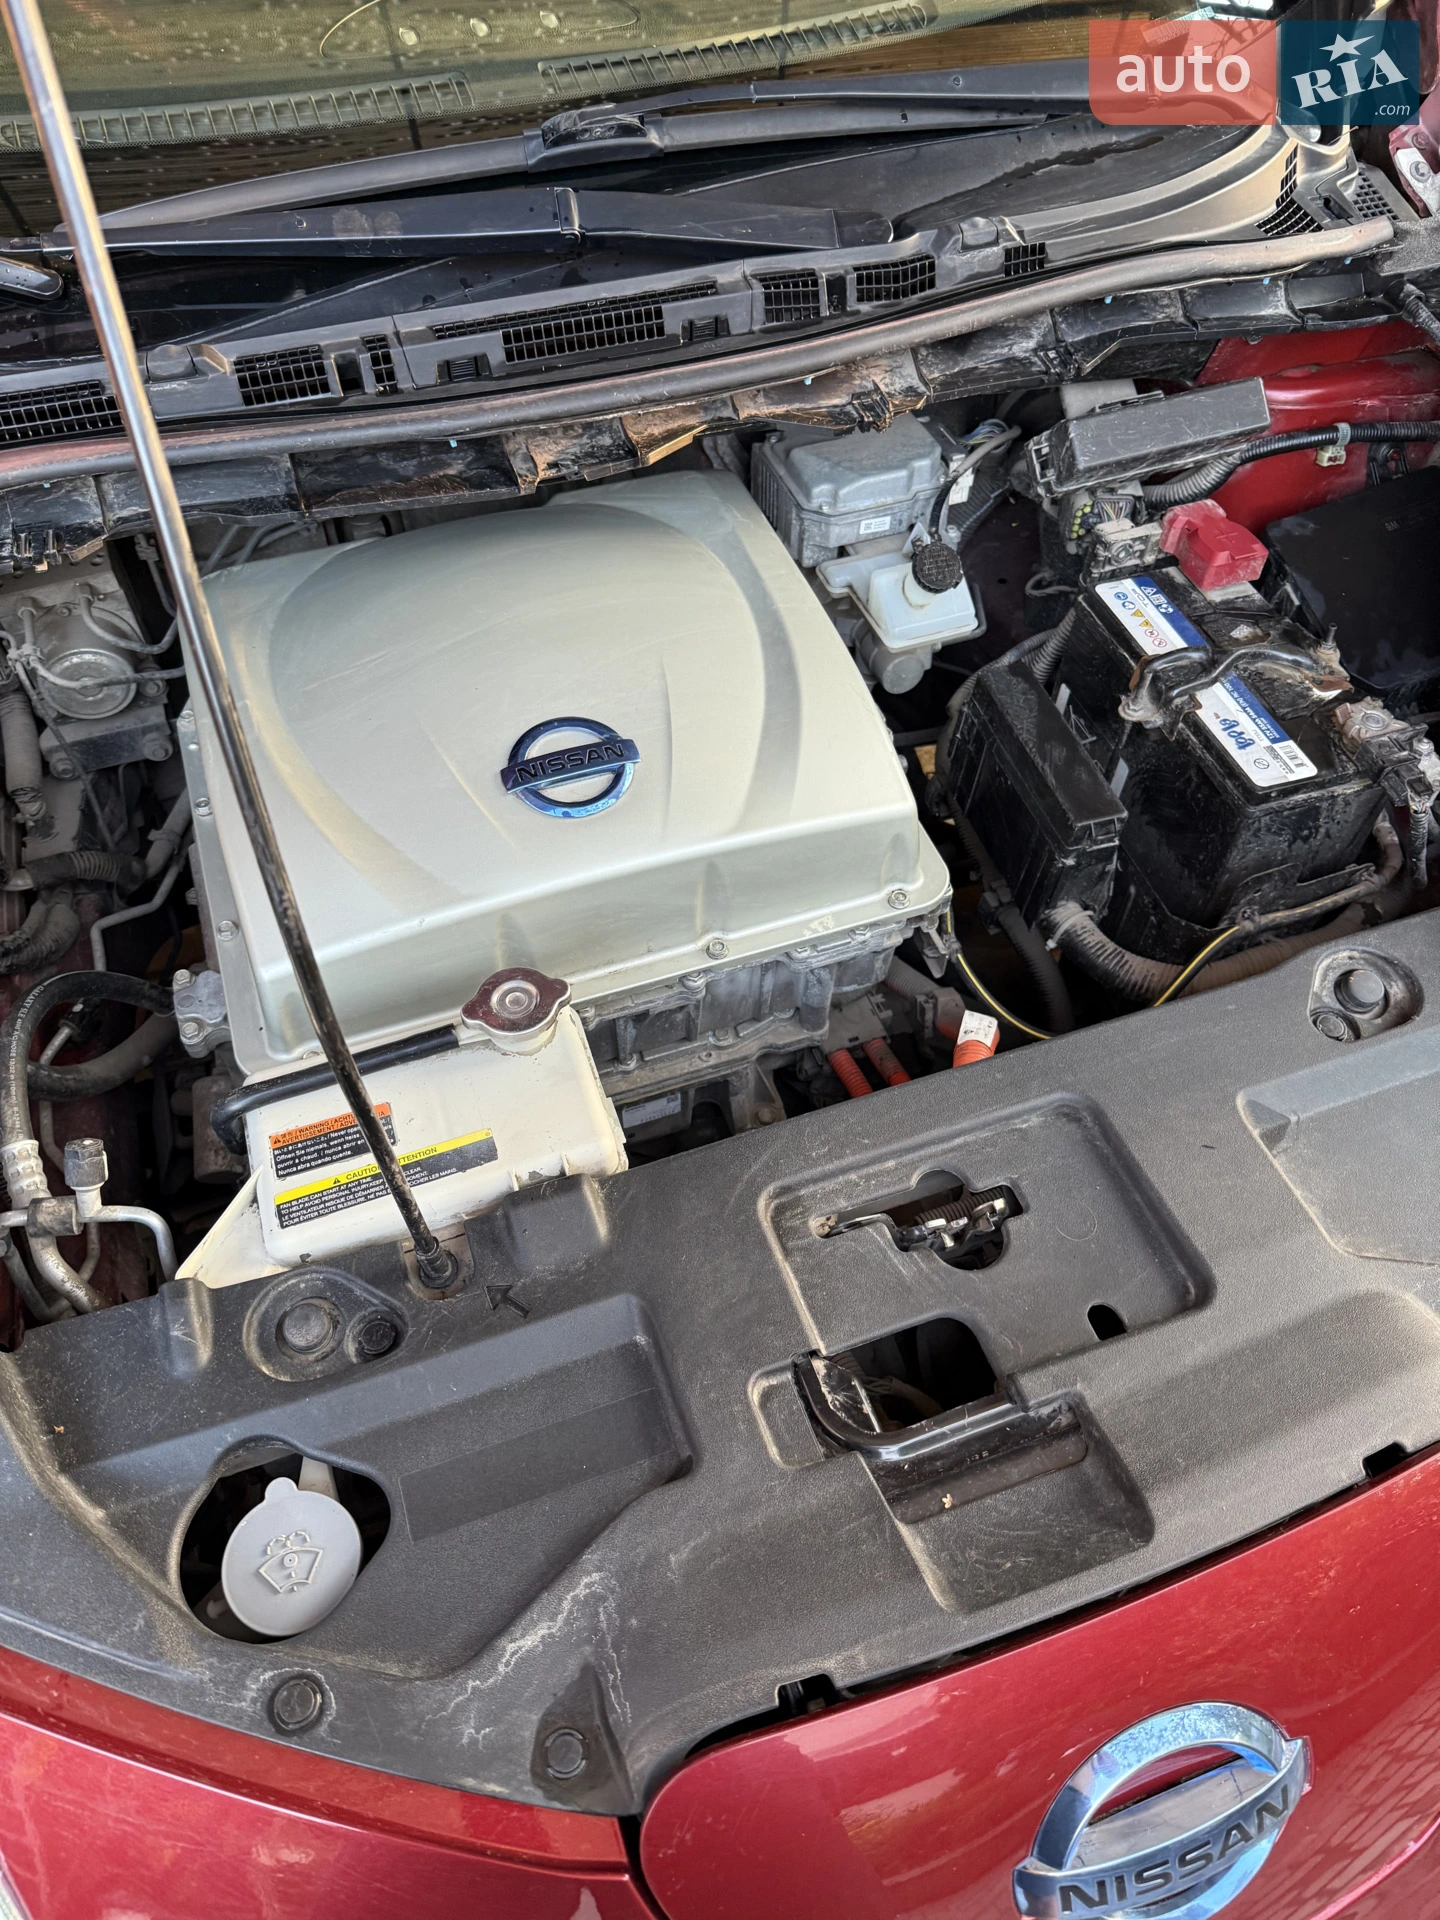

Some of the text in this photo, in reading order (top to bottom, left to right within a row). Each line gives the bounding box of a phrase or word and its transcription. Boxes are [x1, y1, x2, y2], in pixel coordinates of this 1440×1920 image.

[515, 743, 624, 783] NISSAN
[298, 1120, 329, 1133] WARNING
[330, 1129, 346, 1138] Never
[282, 1126, 335, 1144] AVERTISSEMENT
[397, 1147, 438, 1164] TTENTION
[278, 1166, 297, 1175] Nunca
[297, 1162, 310, 1170] abra
[346, 1165, 380, 1181] CAUTIO
[289, 1203, 304, 1212] HELP
[321, 1189, 351, 1202] PERSONAL
[291, 1196, 309, 1205] BLADE
[309, 1192, 322, 1200] CAN
[347, 1180, 359, 1188] ANY
[289, 1203, 325, 1218] VENTILATEUR
[283, 1217, 299, 1226] POUR
[1057, 1783, 1289, 1916] NISSAN
